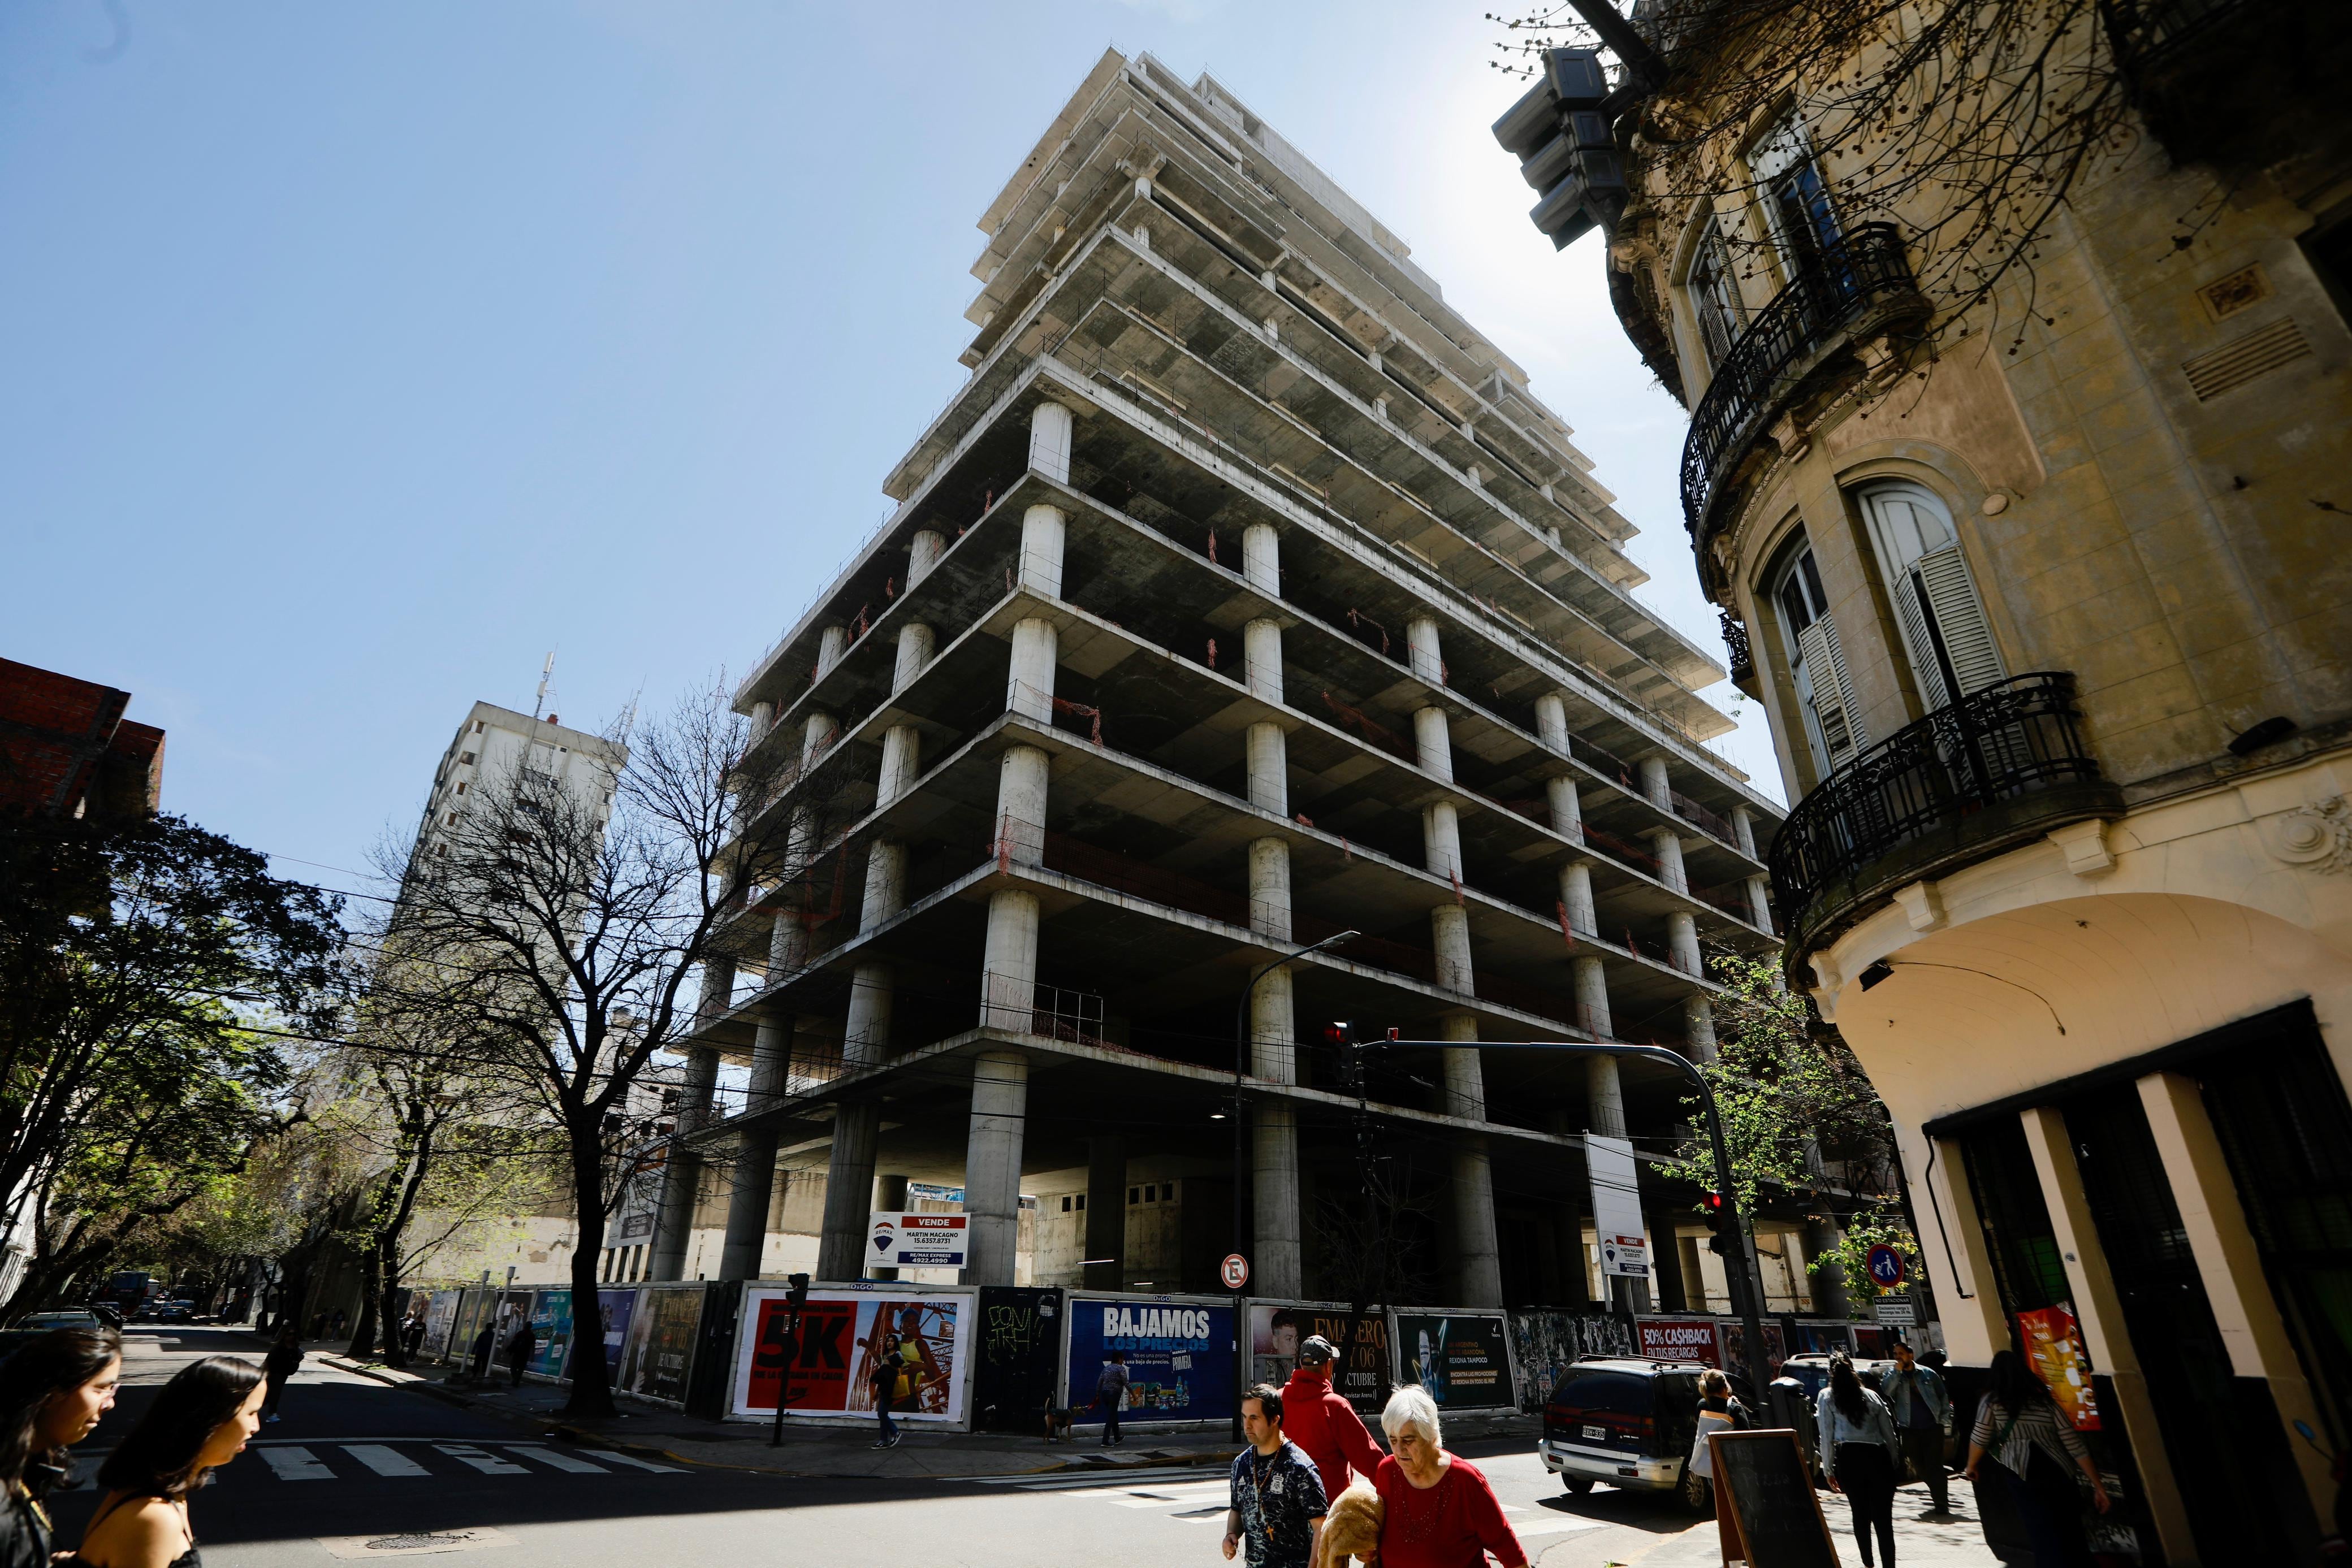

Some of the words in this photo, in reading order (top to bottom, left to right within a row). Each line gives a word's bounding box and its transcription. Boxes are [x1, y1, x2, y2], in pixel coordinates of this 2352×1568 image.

[1103, 1307, 1210, 1339] BAJAMOS
[756, 1315, 850, 1368] 5K
[1103, 1337, 1136, 1351] LOS
[1139, 1337, 1211, 1352] PRECIOS
[1644, 1329, 1664, 1345] 50%
[1665, 1327, 1711, 1346] CA$HBACK
[1360, 1347, 1375, 1368] 06
[1646, 1348, 1655, 1357] EN
[1655, 1347, 1667, 1358] TUS
[1668, 1347, 1698, 1358] RECARGAS
[1172, 1355, 1192, 1371] PRIMERA
[1345, 1372, 1377, 1386] CTUBRE
